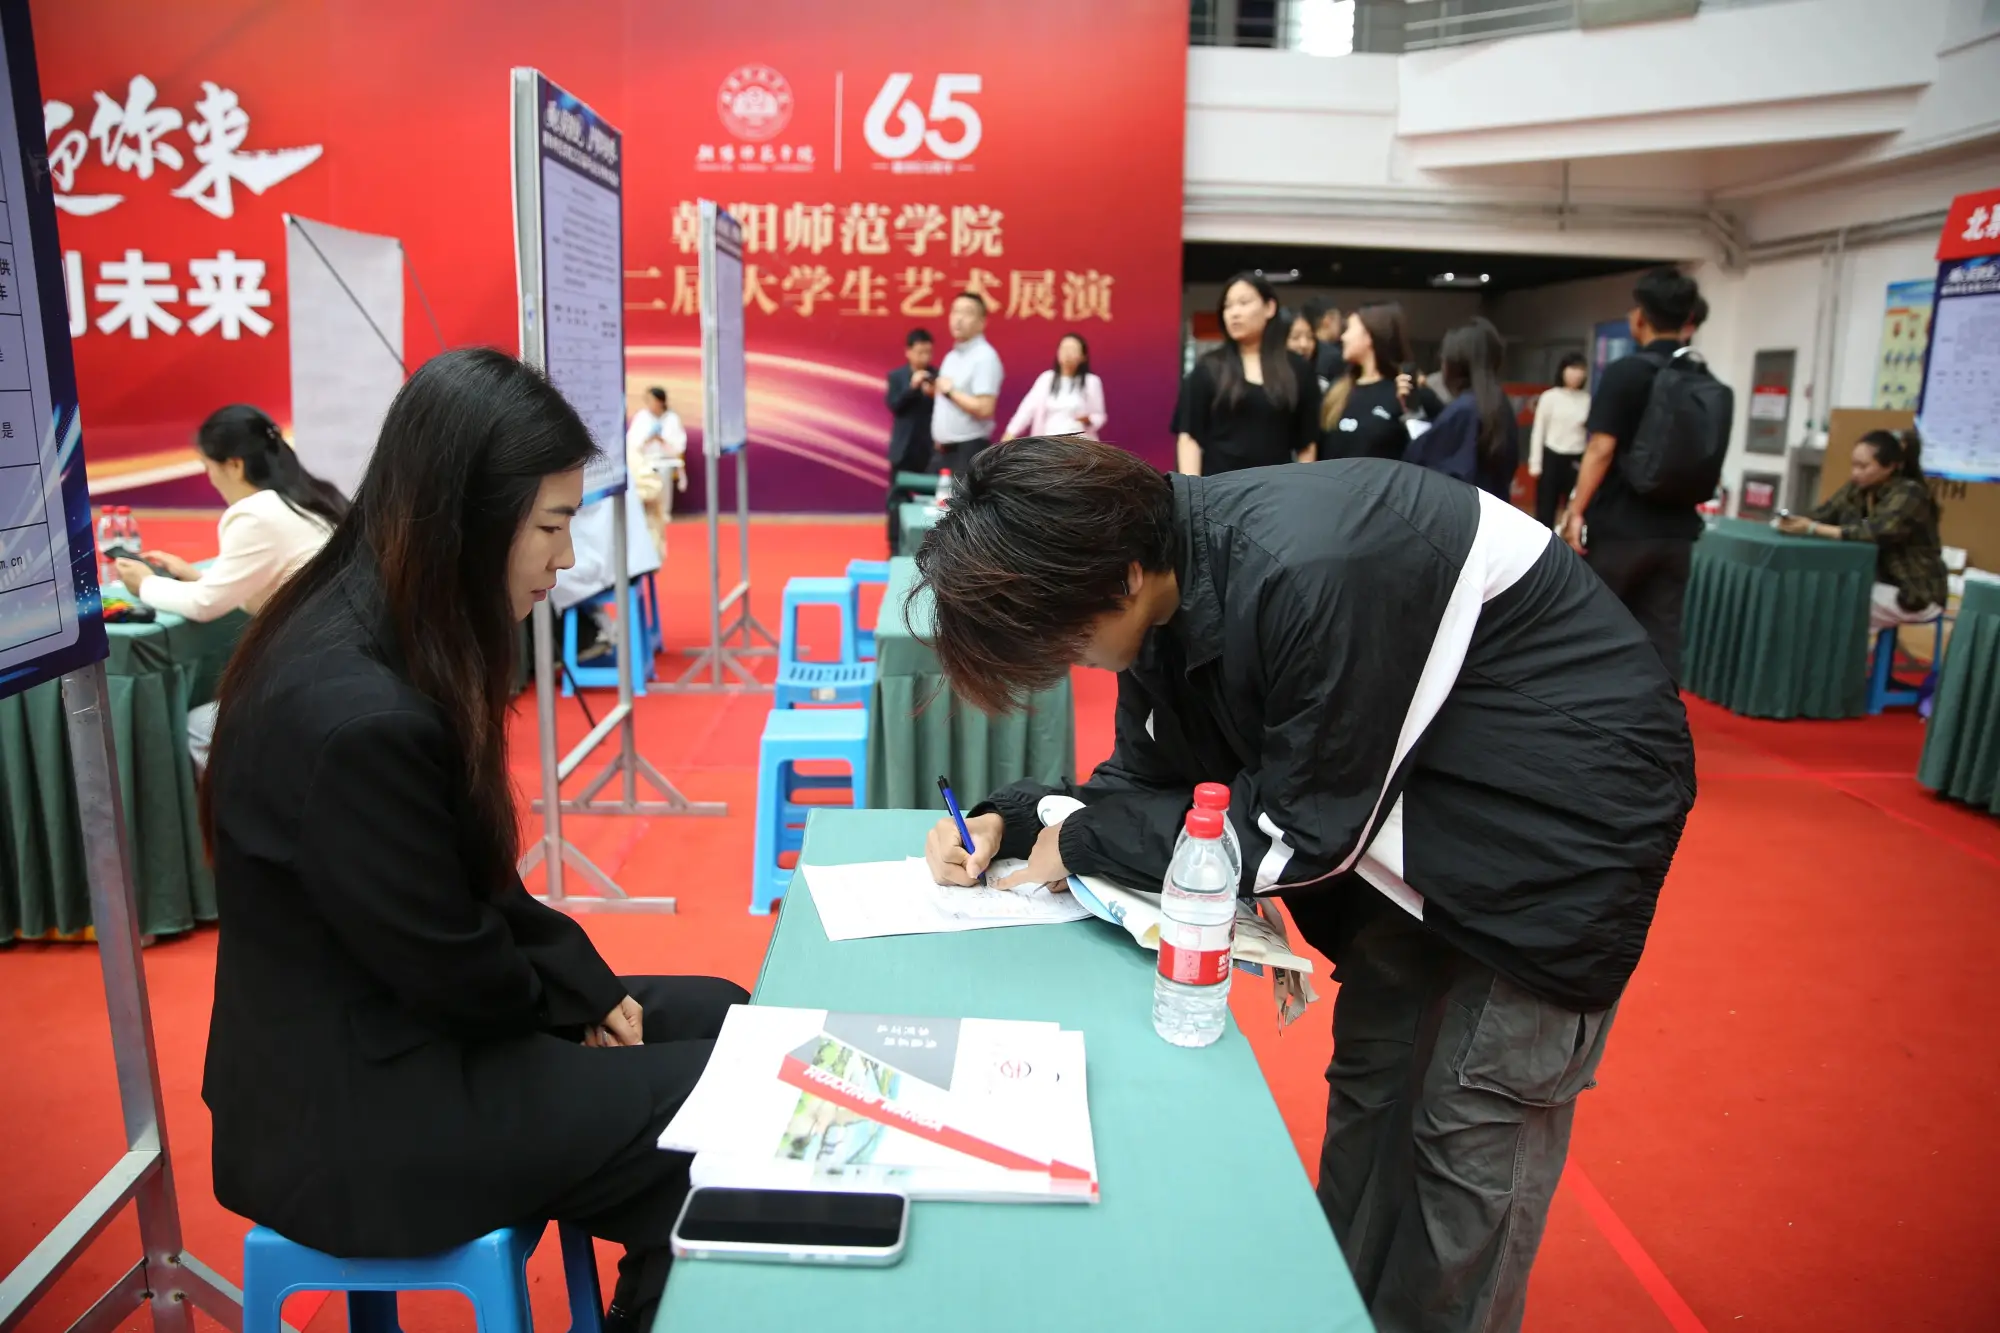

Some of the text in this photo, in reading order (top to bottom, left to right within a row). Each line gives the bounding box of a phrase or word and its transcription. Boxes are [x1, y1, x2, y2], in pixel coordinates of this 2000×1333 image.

[863, 72, 983, 160] 65
[62, 249, 274, 340] 未来
[2, 421, 14, 438] 是
